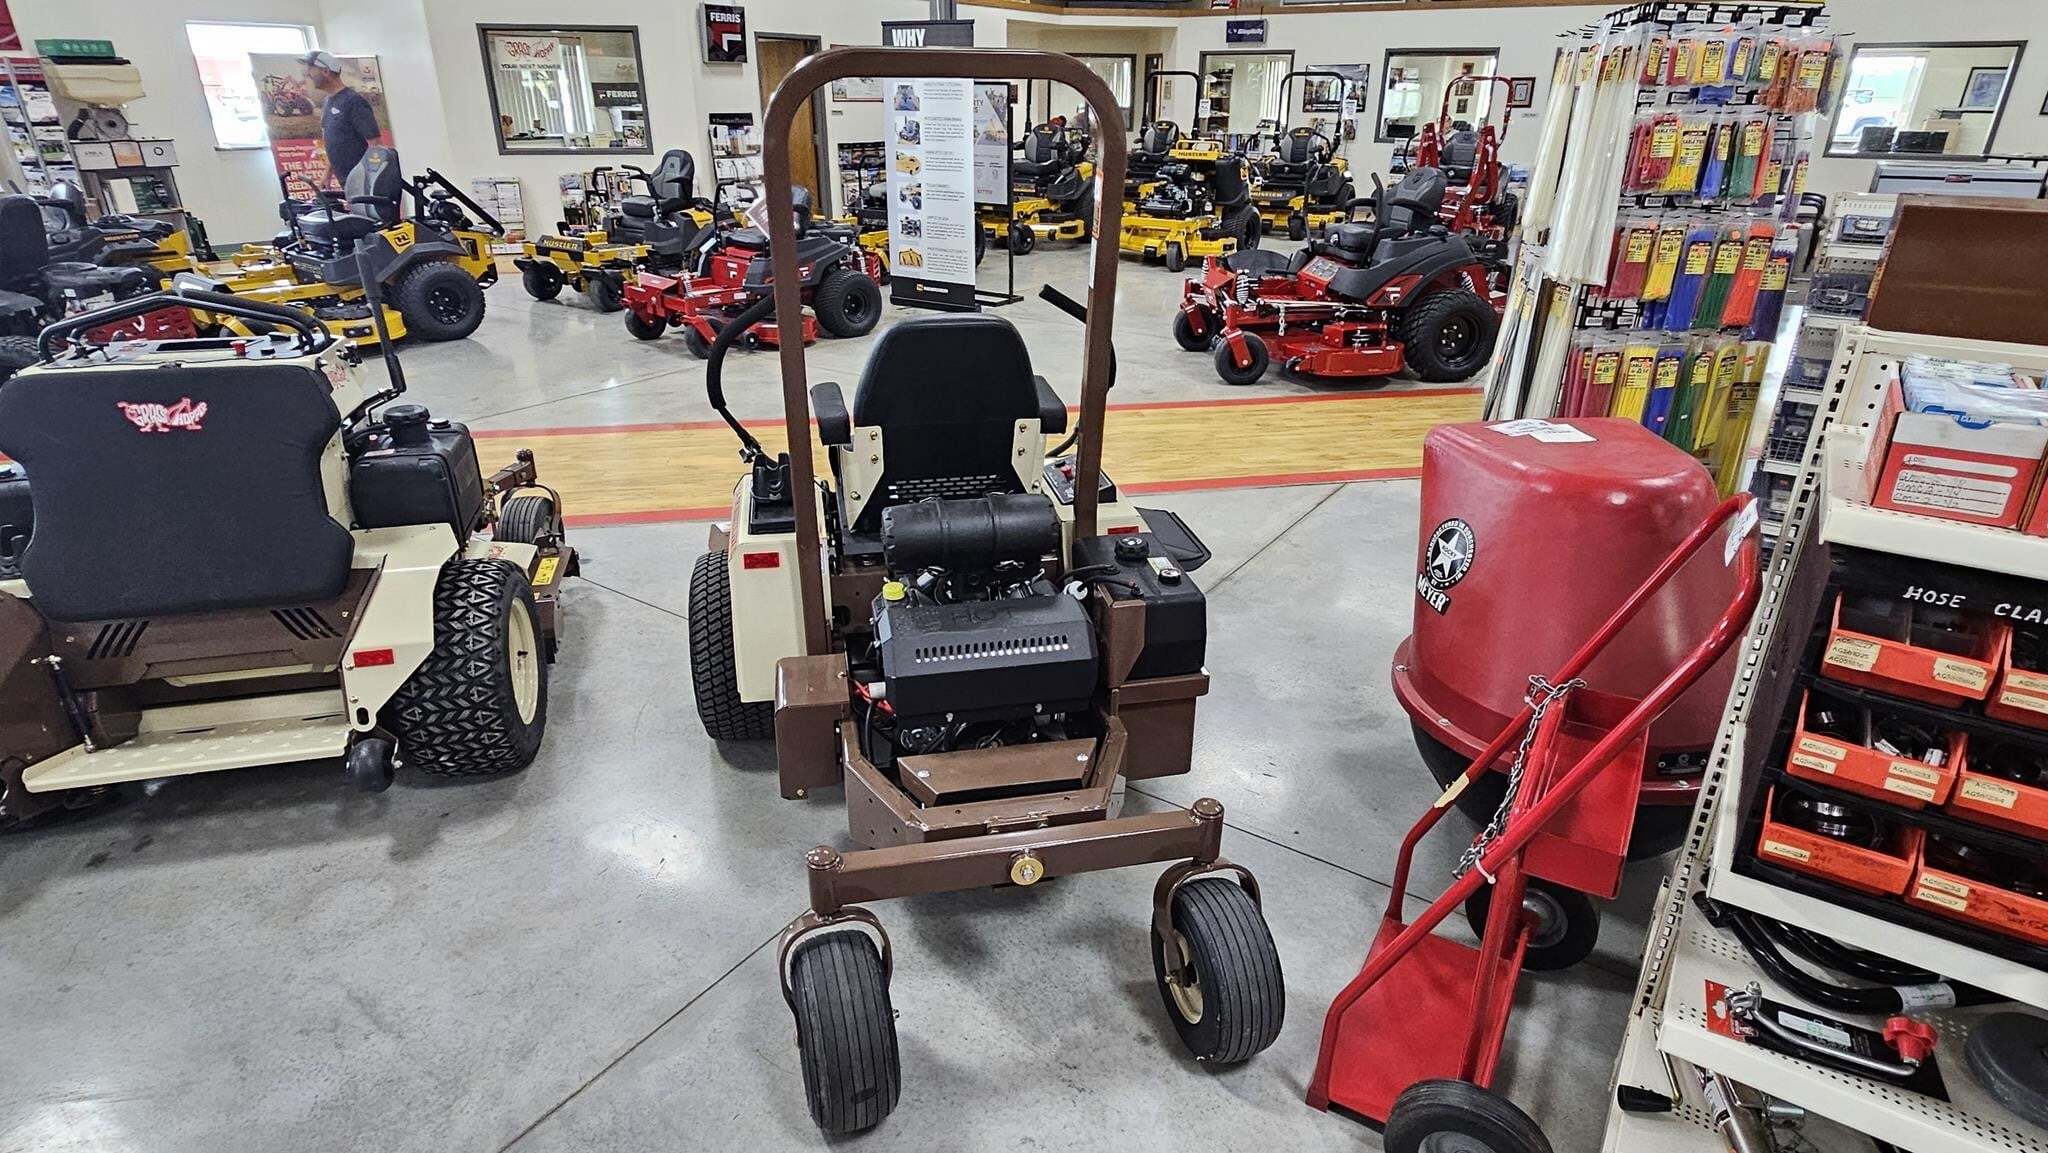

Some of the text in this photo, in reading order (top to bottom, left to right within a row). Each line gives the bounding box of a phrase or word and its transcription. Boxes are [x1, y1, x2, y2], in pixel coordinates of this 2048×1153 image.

[709, 11, 741, 23] FERRIS
[892, 28, 926, 47] WHY
[606, 90, 638, 98] FERRIS
[543, 239, 578, 249] HUSTLER
[1416, 572, 1446, 613] MEYER
[1902, 585, 2048, 626] HOSE CLA
